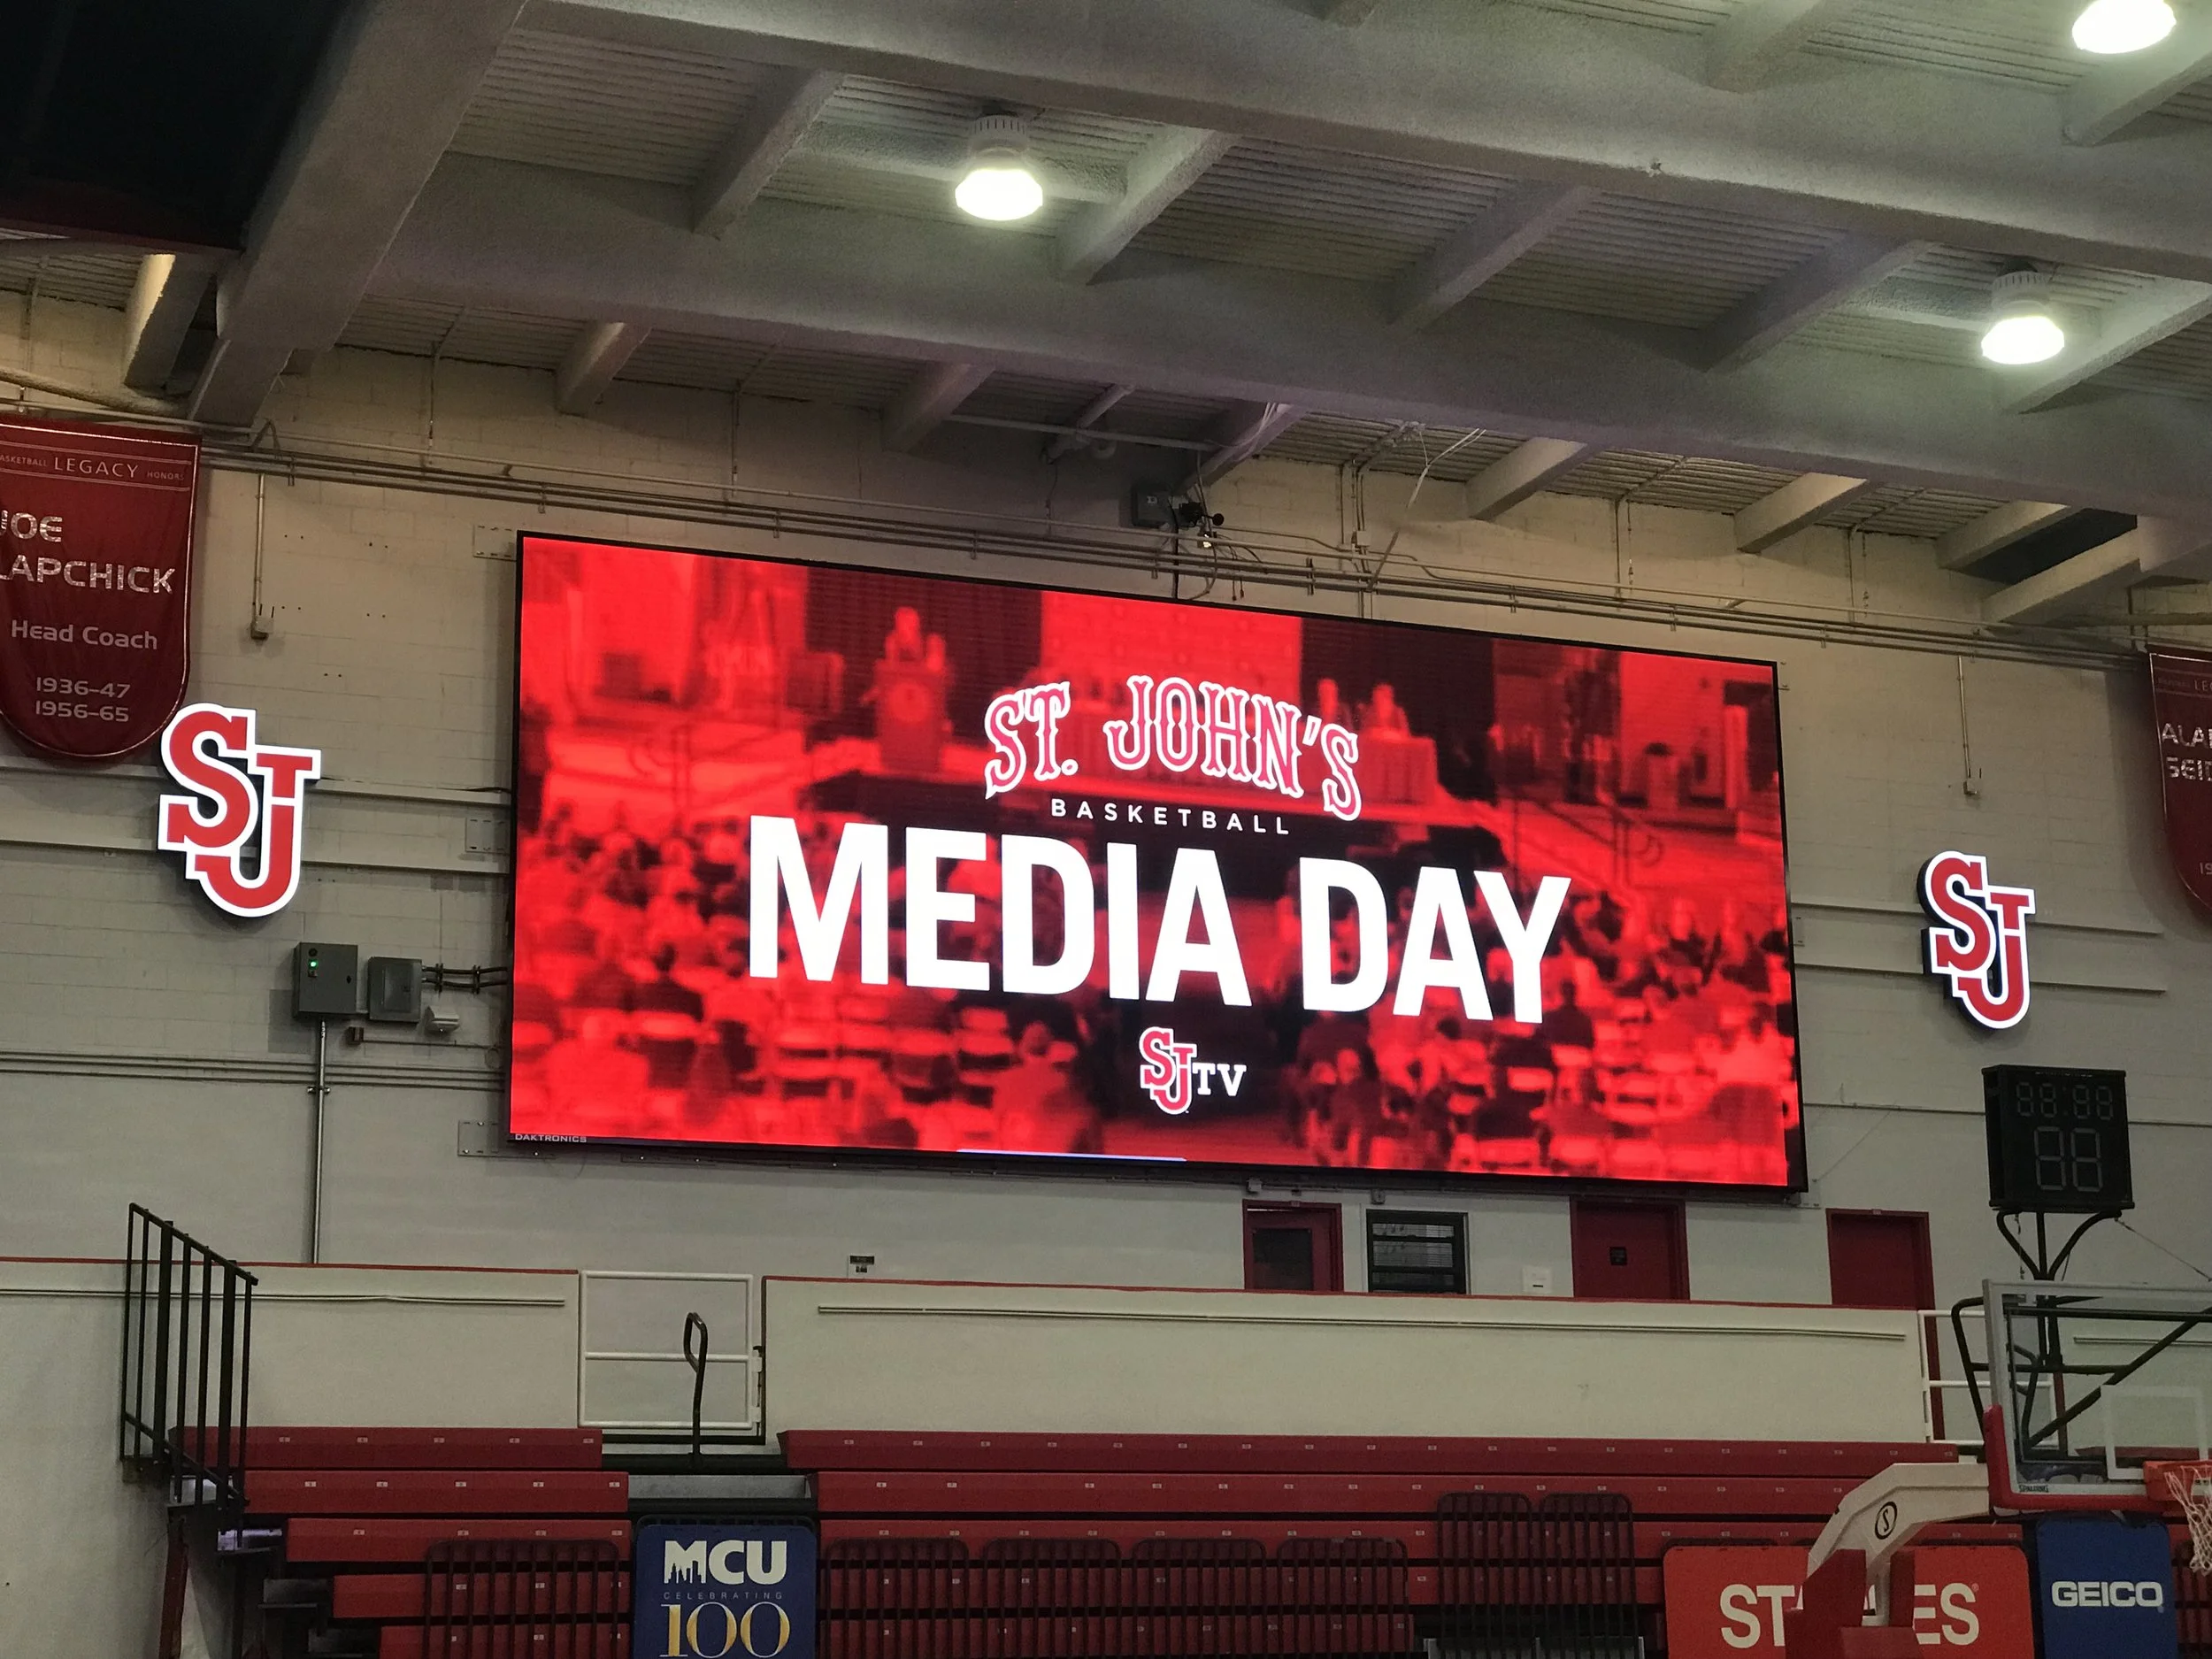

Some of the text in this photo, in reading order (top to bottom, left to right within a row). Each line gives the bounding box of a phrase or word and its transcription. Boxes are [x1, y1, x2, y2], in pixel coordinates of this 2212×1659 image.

[0, 455, 185, 480] ASKETBALL LEGACY HONORS
[12, 619, 157, 650] Head Coach
[984, 675, 1362, 821] ST. JOHN'S
[1051, 798, 1289, 835] BASKETBALL
[749, 814, 1571, 1024] MEDIA DAY
[515, 1133, 588, 1143] DAKTRONICS
[664, 1540, 787, 1585] MCU
[2051, 1581, 2164, 1608] GEICO
[659, 1601, 791, 1659] 100
